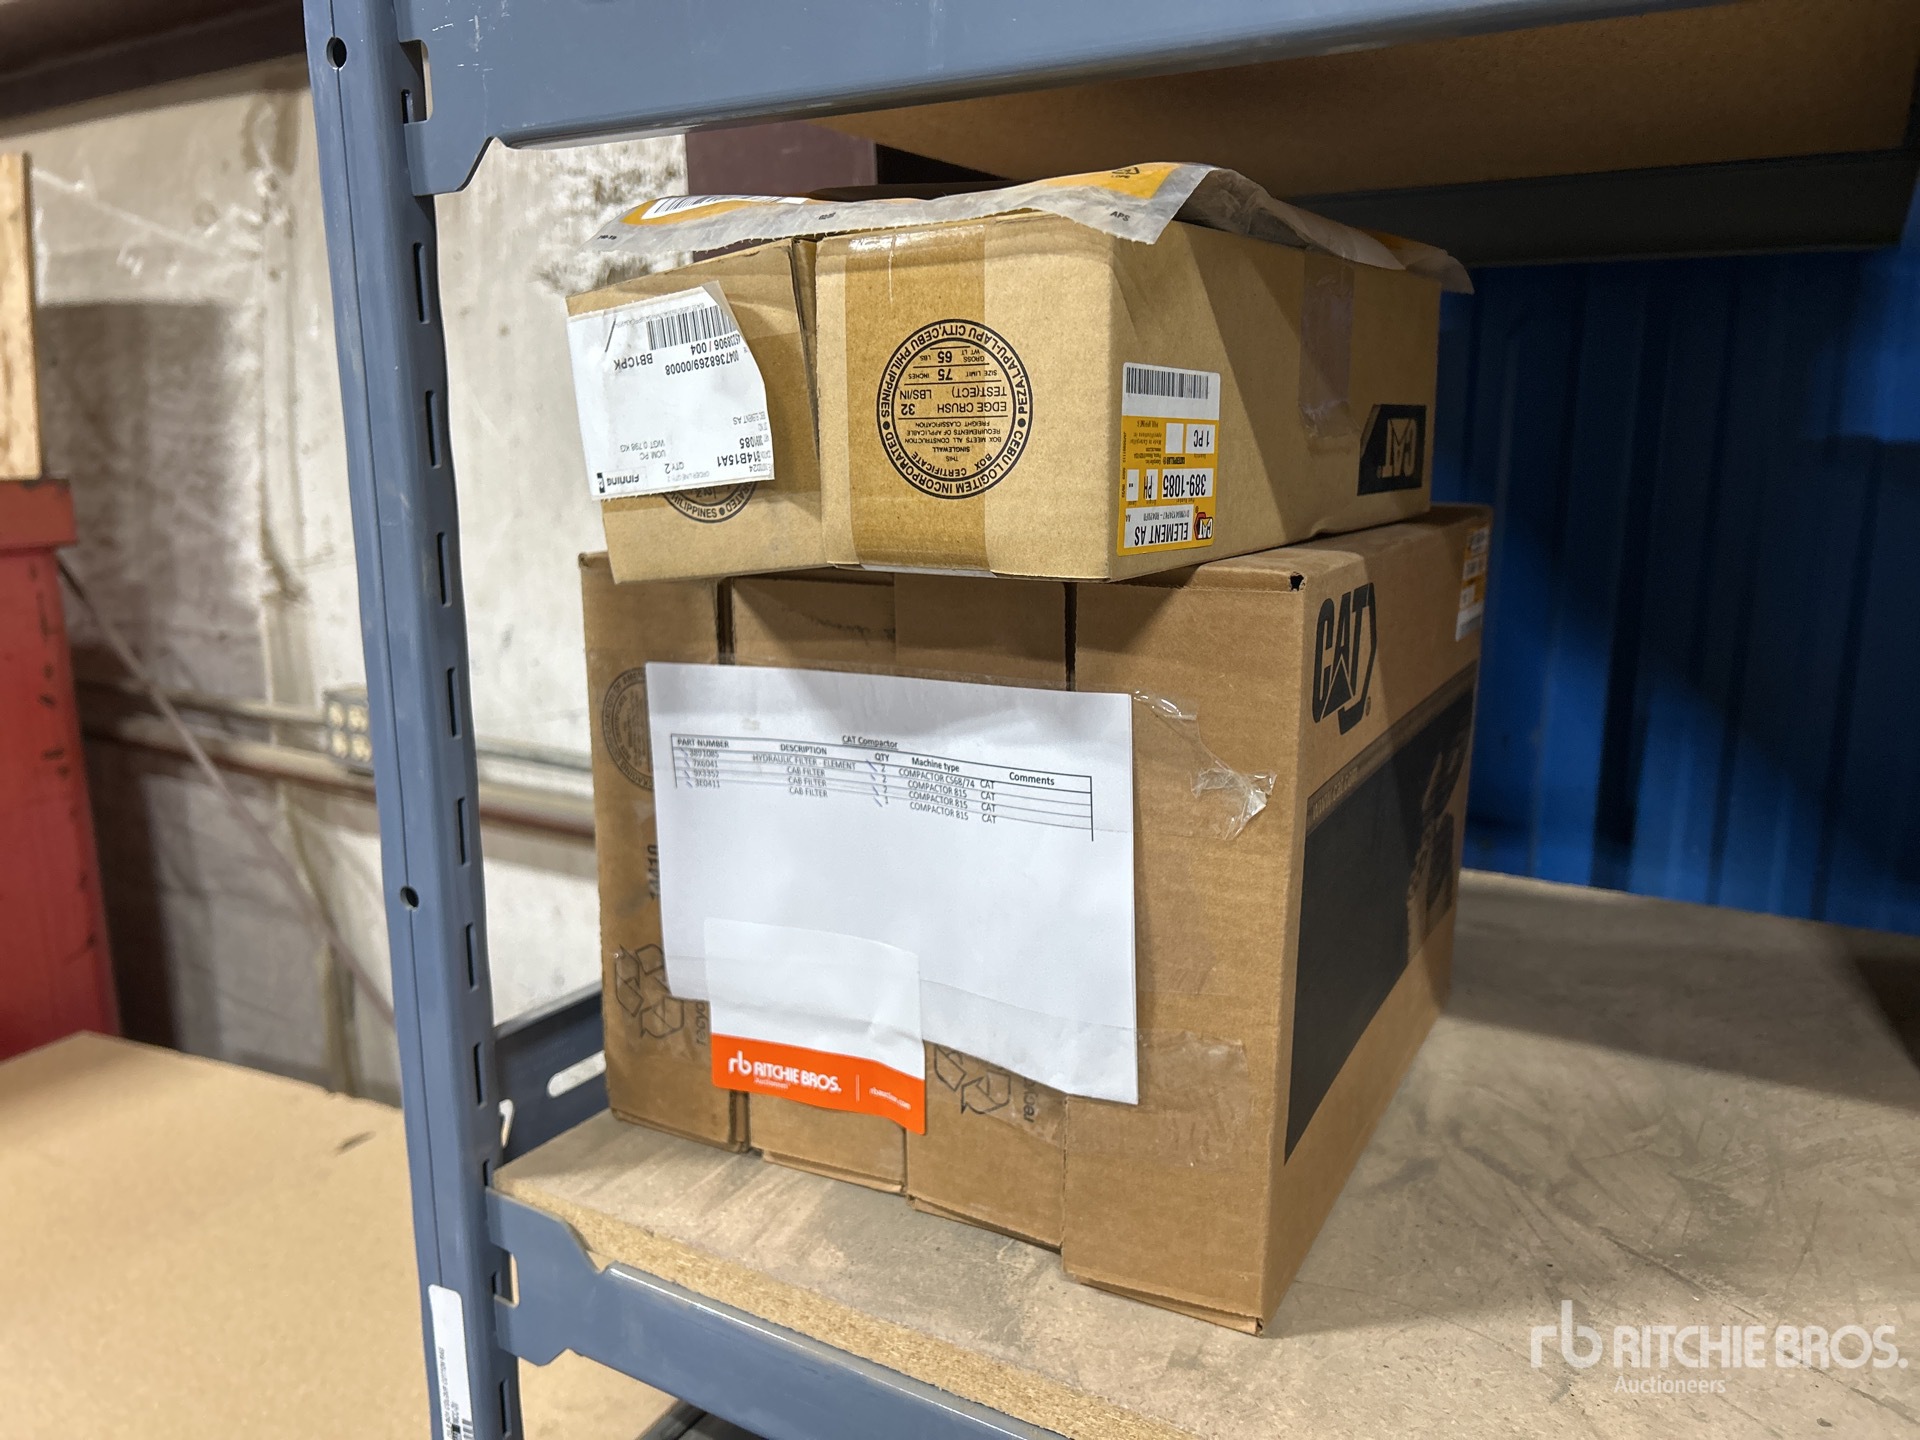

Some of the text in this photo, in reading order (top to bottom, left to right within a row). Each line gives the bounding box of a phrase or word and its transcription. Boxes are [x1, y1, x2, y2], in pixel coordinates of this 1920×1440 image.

[1109, 210, 1131, 222] APS
[690, 342, 707, 355] 004
[937, 351, 953, 363] 65
[613, 353, 653, 371] BB1CPK
[881, 346, 910, 418] PHILIPPINES
[937, 368, 953, 381] 75
[899, 386, 1007, 400] TEST(ECT) LBS/IN
[901, 401, 1007, 416] EDGE CRUSH 32
[733, 415, 742, 425] AS
[619, 444, 630, 453] KG
[1193, 430, 1209, 448] 1 PC
[1377, 417, 1417, 479] CAT
[639, 452, 649, 460] PC
[885, 430, 1022, 493] CEBU LOGITEM INCORPORATED
[911, 451, 992, 477] BOX CERTIFICATE
[664, 463, 670, 474] 2
[1144, 476, 1152, 499] PH
[1163, 474, 1206, 497] 389-1085
[1134, 523, 1188, 545] ELEMENT AS
[1197, 518, 1212, 539] CAT
[1312, 583, 1374, 729] CAT
[842, 735, 898, 749] CAT Compactor
[697, 740, 729, 748] NUMBER
[780, 744, 827, 754] DESCRIPTION
[875, 753, 889, 762] QTY
[911, 757, 942, 770] Machine
[943, 763, 960, 772] type
[1009, 772, 1055, 786] Comments
[752, 754, 792, 763] HYDRAULIC
[795, 756, 817, 765] FILTER
[823, 760, 856, 770] ELEMENT
[899, 768, 944, 782] COMPACTOR
[980, 780, 995, 790] CAT
[787, 766, 801, 774] CAB
[803, 768, 825, 777] FILTER
[882, 775, 887, 783] 2
[908, 780, 953, 796] COMPACTOR
[954, 789, 967, 798] 815
[981, 791, 996, 801] CAT
[788, 776, 802, 785] CAB
[804, 778, 827, 787] FILTER
[909, 791, 954, 807] COMPACTOR
[954, 800, 968, 809] 815
[981, 802, 997, 813] CAT
[789, 787, 804, 795] CAB
[805, 789, 828, 797] FILTER
[910, 802, 955, 818] COMPACTOR
[956, 811, 969, 821] 815
[982, 814, 997, 824] CAT
[728, 1050, 842, 1093] rb RITCHIE BROS.
